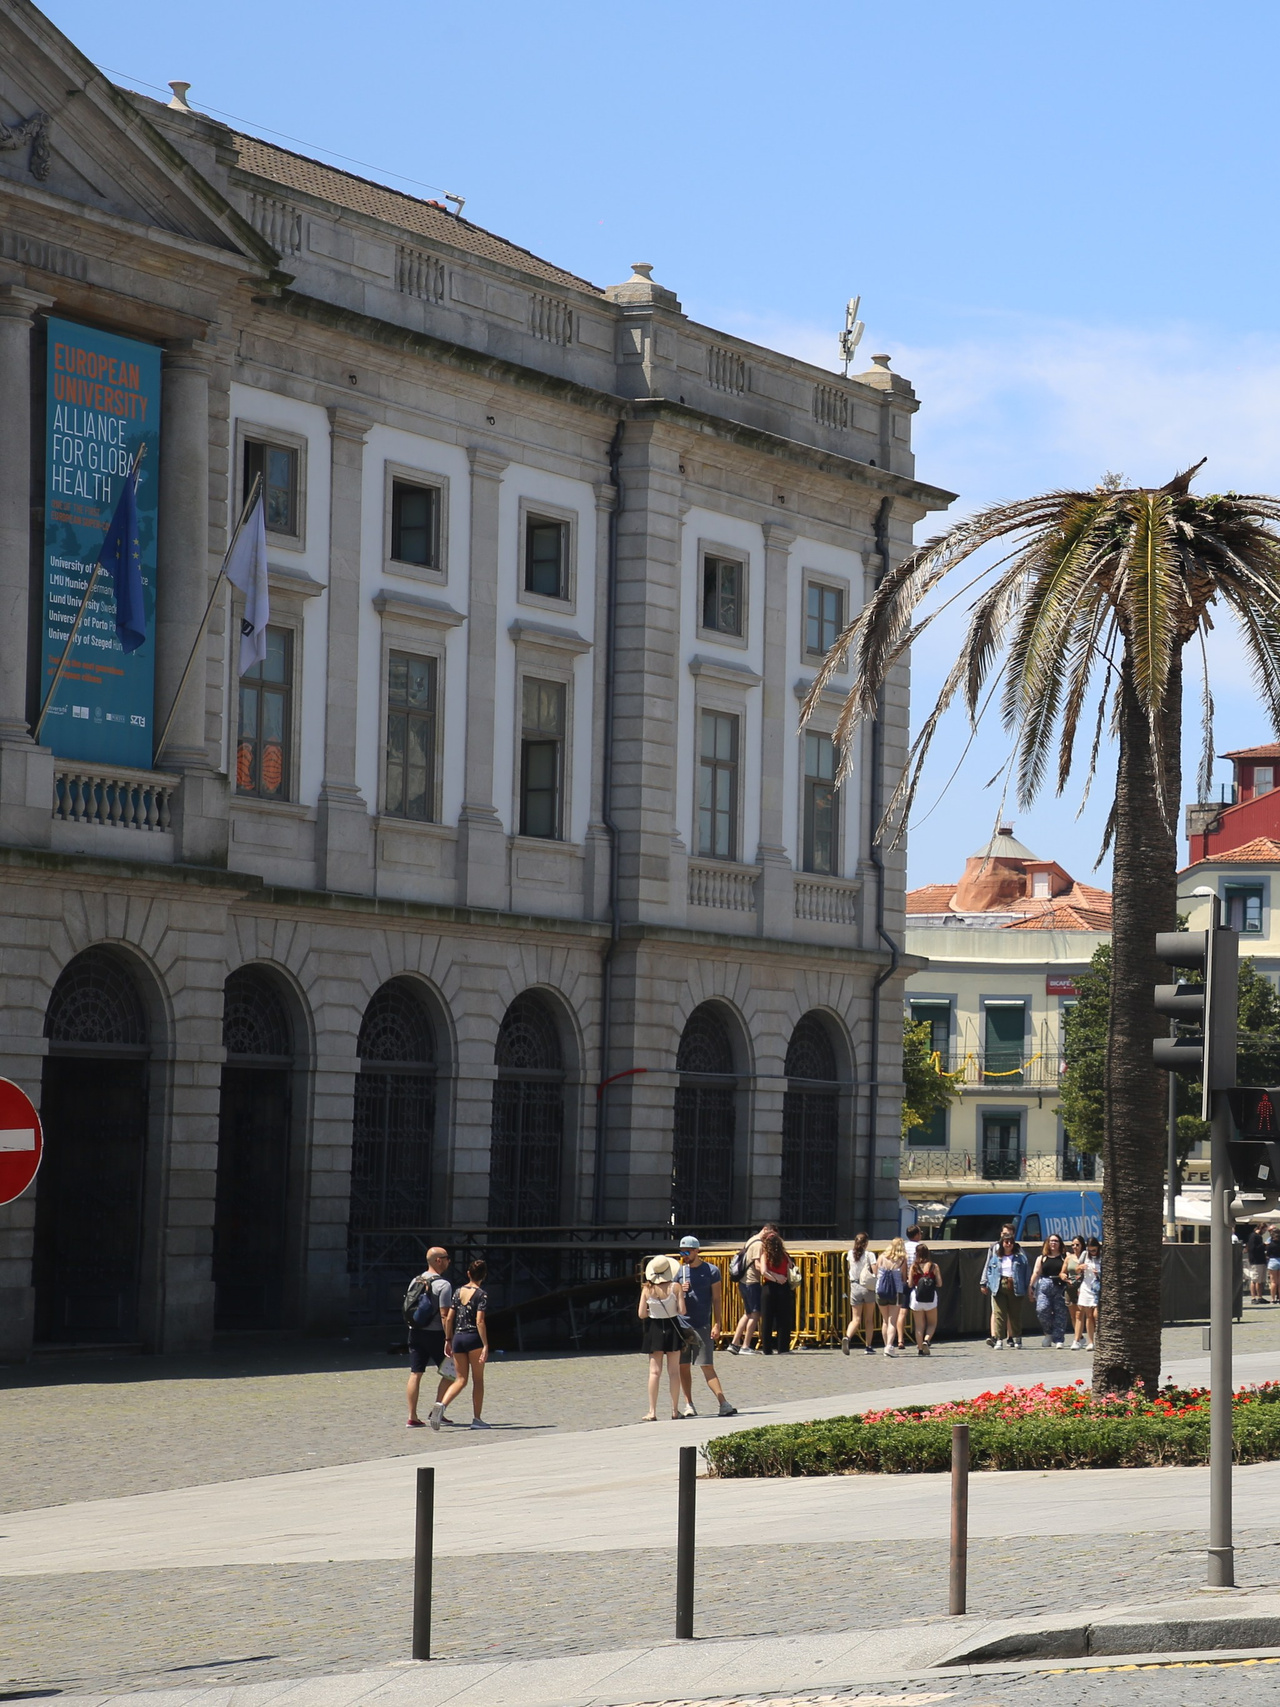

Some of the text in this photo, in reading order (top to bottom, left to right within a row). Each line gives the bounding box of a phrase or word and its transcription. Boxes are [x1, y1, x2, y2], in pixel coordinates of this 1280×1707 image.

[54, 342, 140, 391] EUROPEAN
[54, 372, 148, 422] UNIVERSITY
[53, 404, 127, 448] ALLIANCE
[53, 434, 143, 482] FOR GLOBA
[52, 464, 111, 503] HEALTH
[50, 555, 85, 574] University
[85, 563, 92, 573] of
[49, 573, 88, 590] LMU Munich
[49, 592, 66, 606] Lund
[66, 595, 100, 613] Univrsity
[49, 609, 82, 628] Universiy
[83, 616, 90, 627] of
[91, 617, 108, 630] Porto
[83, 635, 90, 645] of
[91, 635, 113, 650] Szeged
[1045, 1215, 1100, 1241] URBANOS
